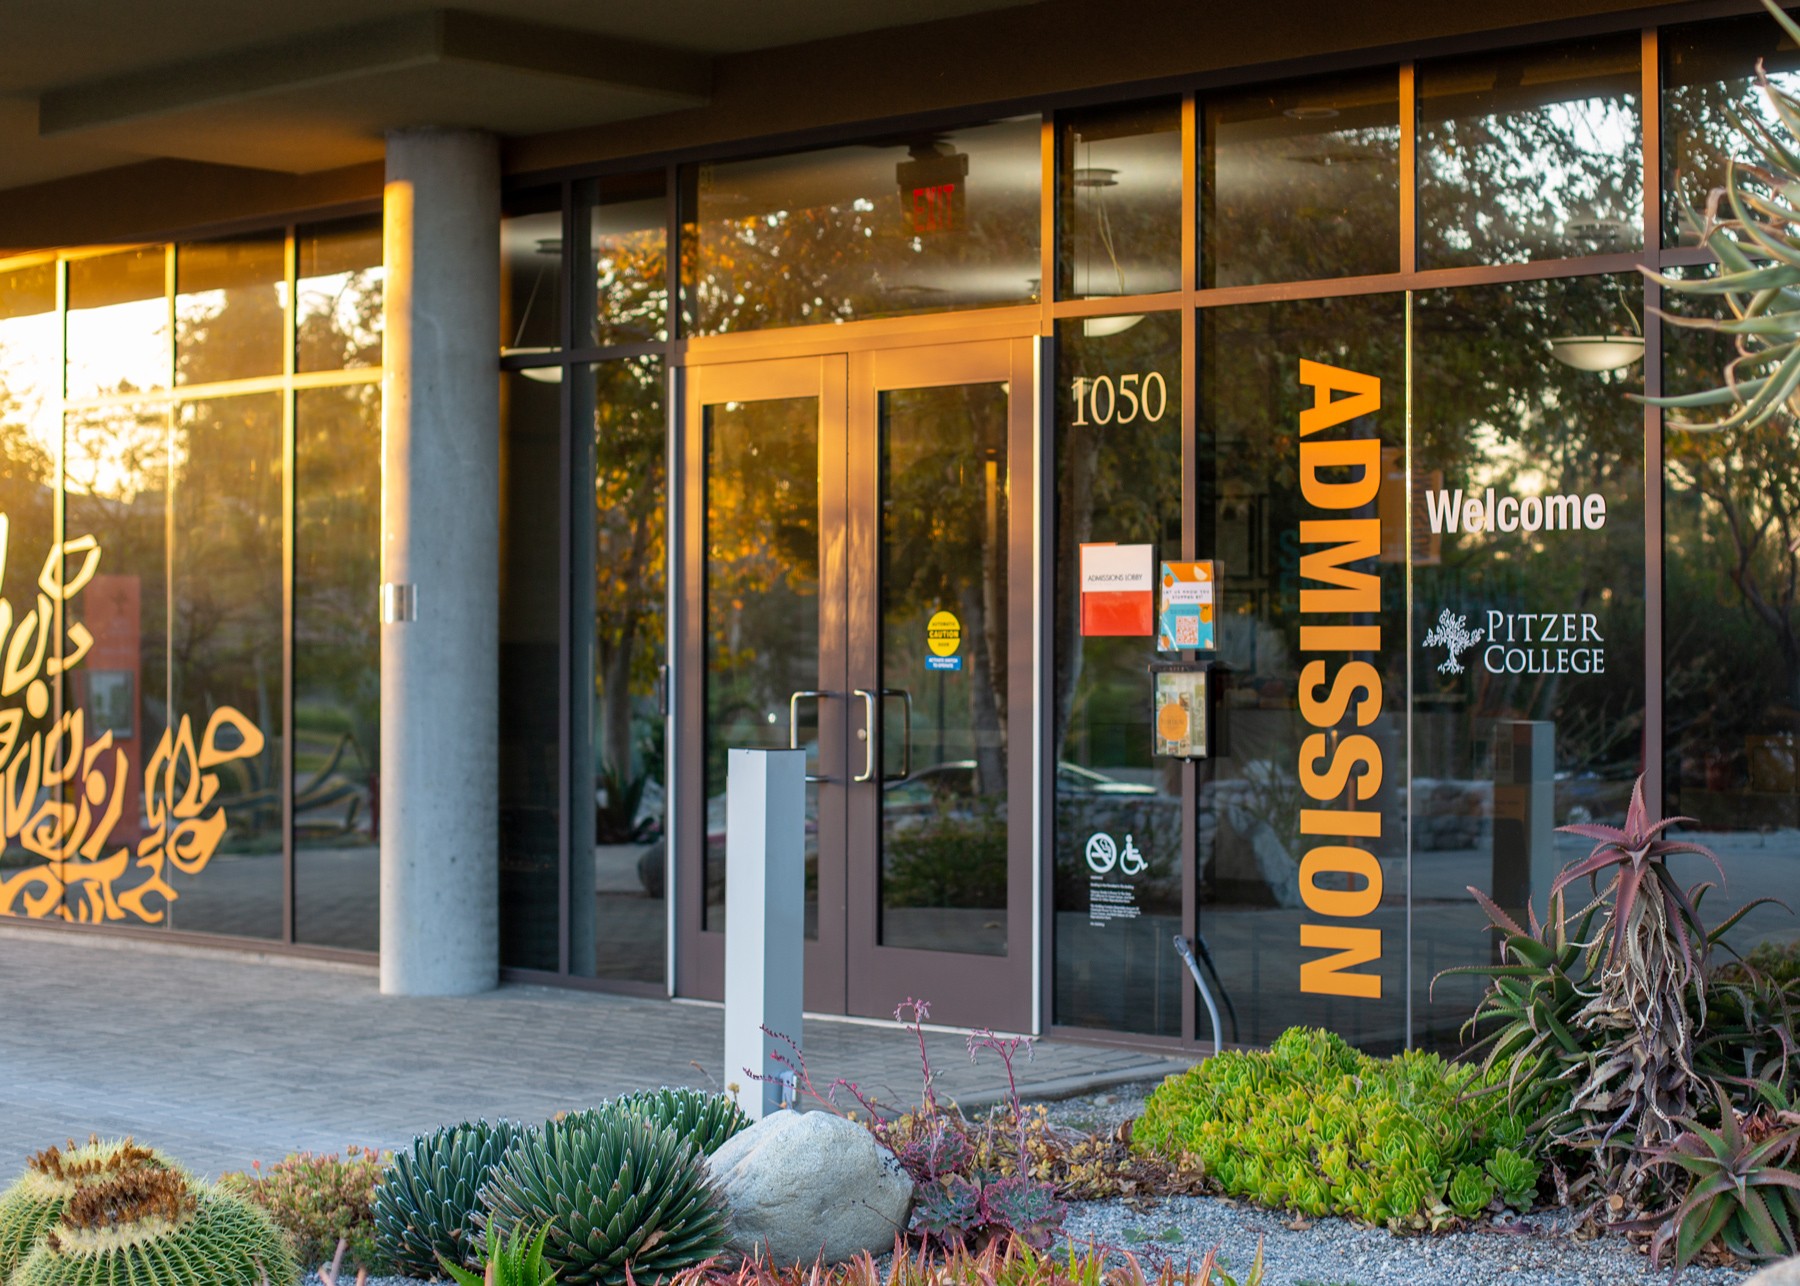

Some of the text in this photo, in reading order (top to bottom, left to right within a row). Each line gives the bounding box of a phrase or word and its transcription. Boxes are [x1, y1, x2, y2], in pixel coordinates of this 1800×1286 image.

[913, 183, 955, 232] EXIT
[1071, 371, 1167, 426] 1050
[1425, 487, 1606, 534] Welcome
[1088, 573, 1143, 582] ADMISSIONS LOBBY
[929, 630, 958, 638] CAUTION
[1486, 610, 1604, 642] PITZER
[1299, 358, 1383, 999] ADMISSION
[1484, 645, 1604, 673] COLLEGE
